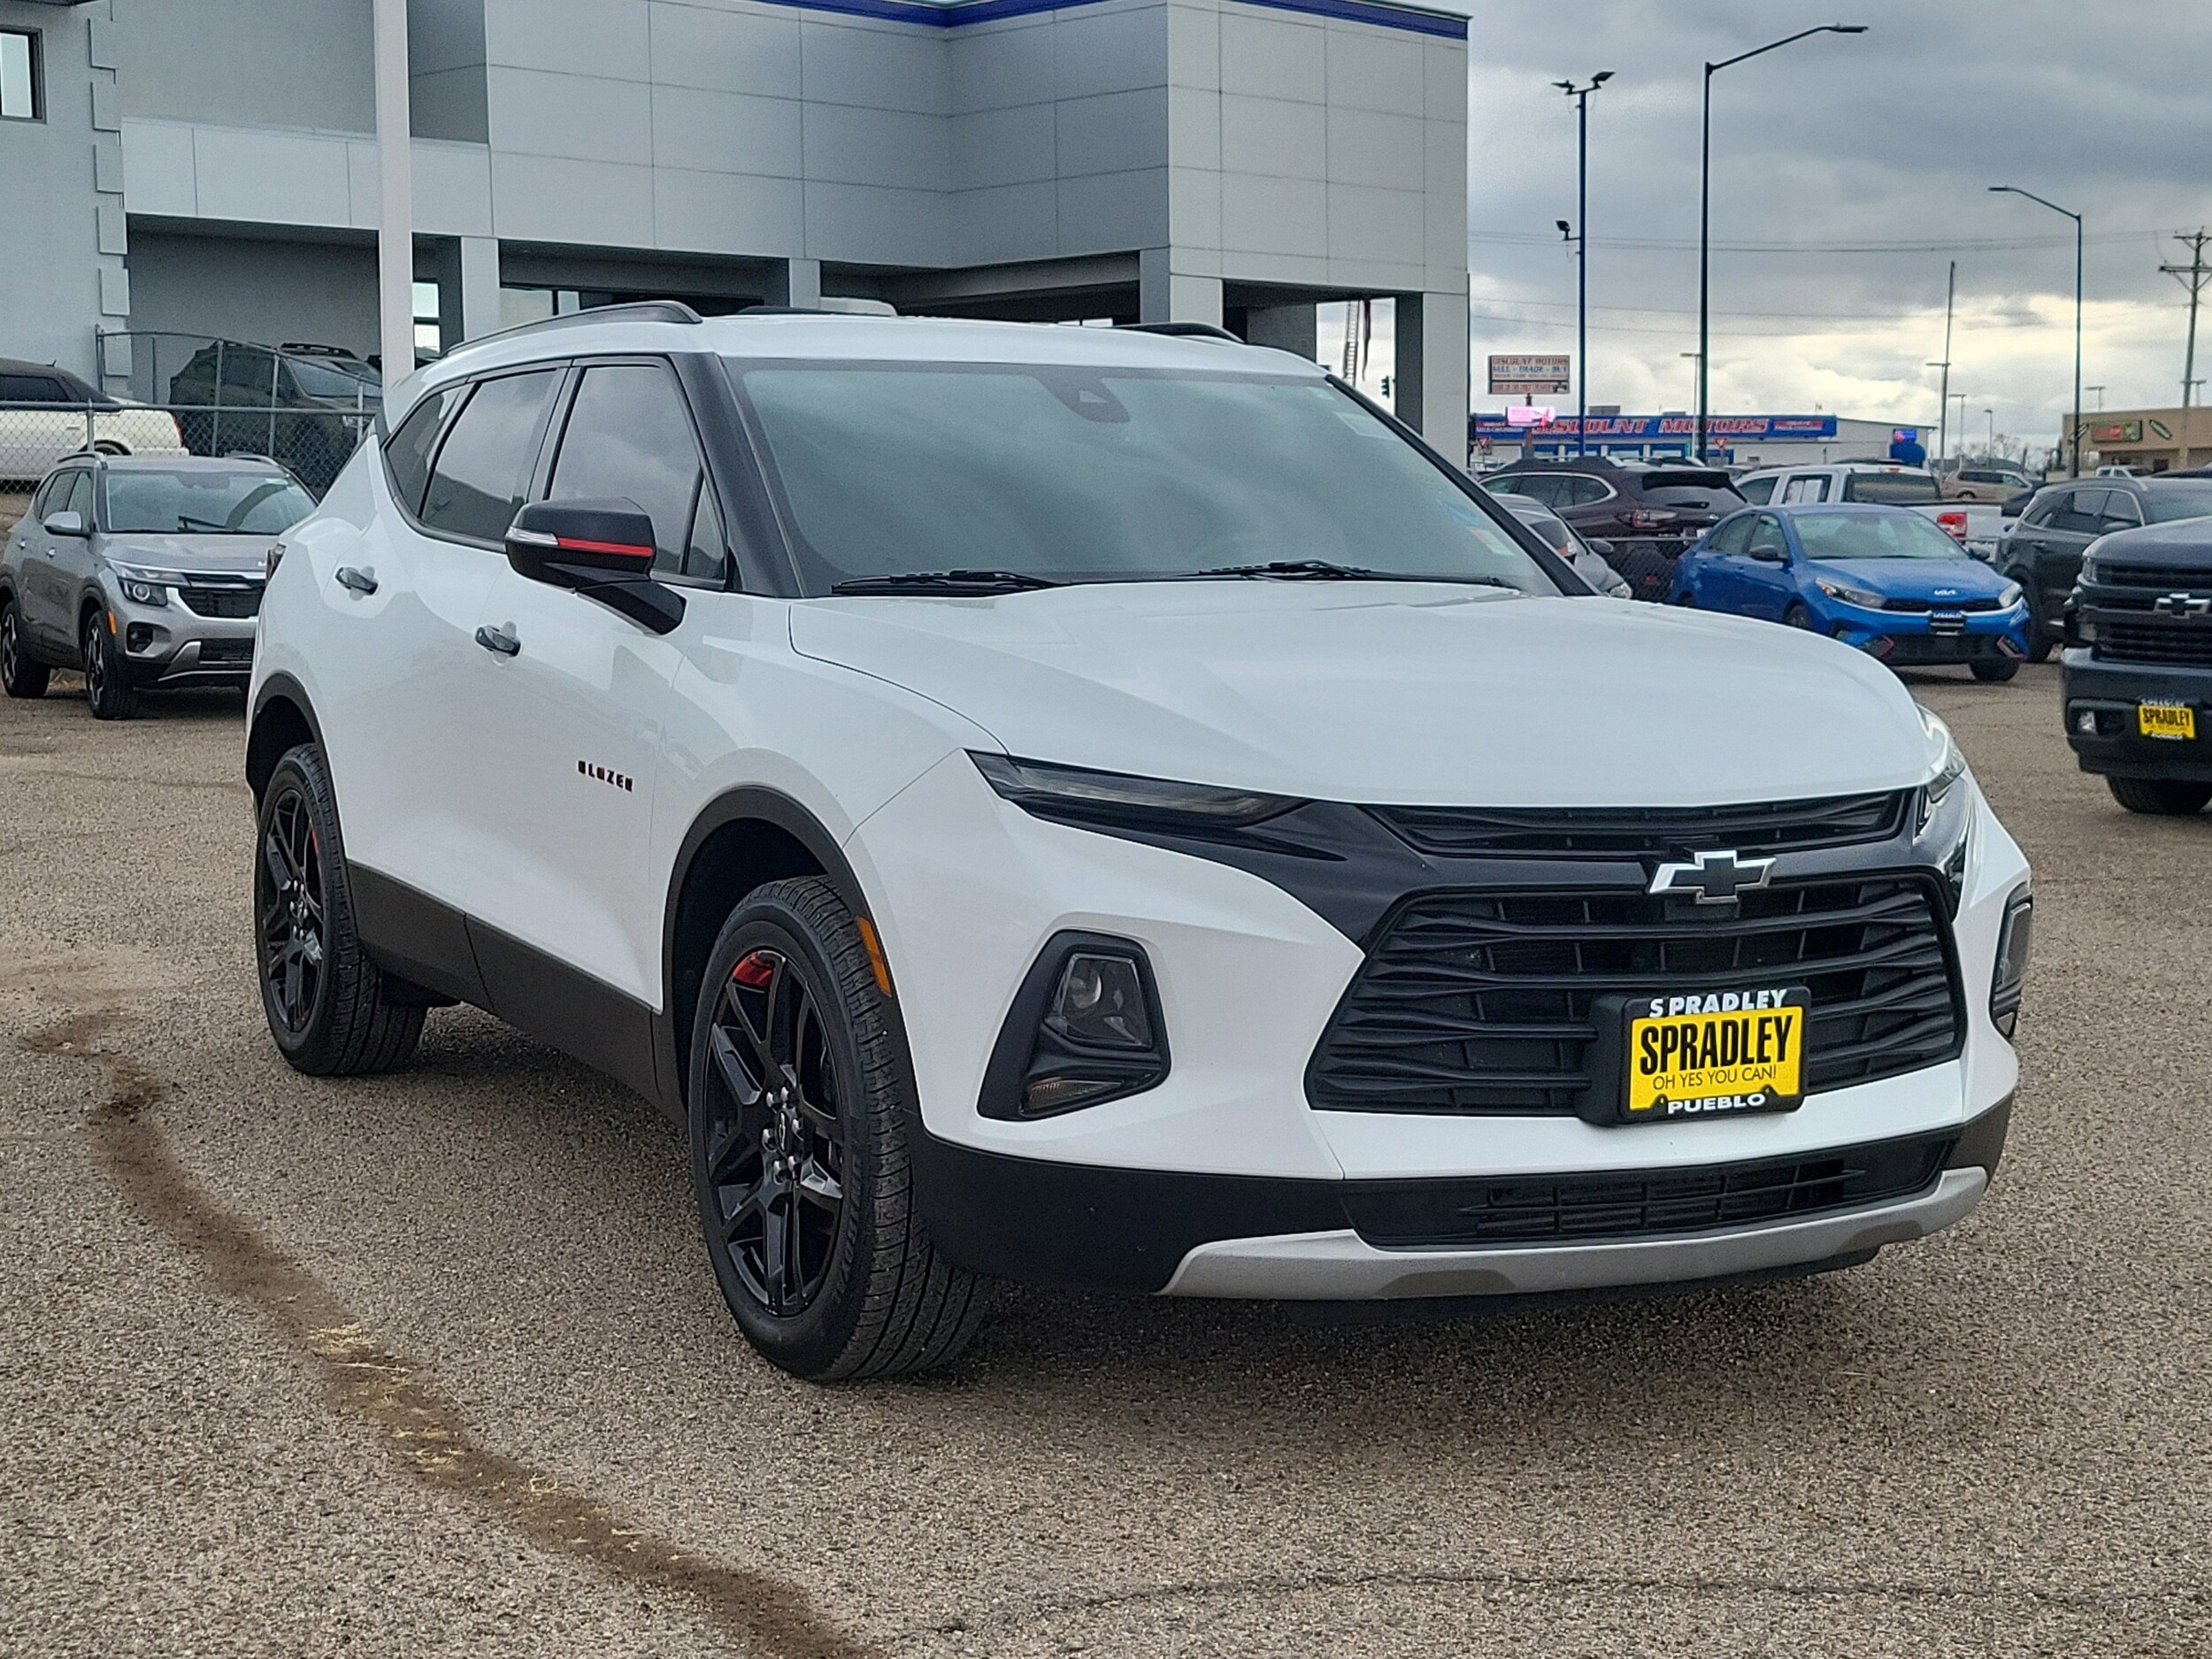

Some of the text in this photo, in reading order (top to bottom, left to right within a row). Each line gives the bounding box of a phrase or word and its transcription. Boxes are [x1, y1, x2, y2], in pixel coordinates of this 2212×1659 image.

[2142, 708, 2190, 726] SPRADLEY
[578, 760, 633, 793] BLAZER
[1648, 988, 1787, 1018] SPRADLEY
[1640, 1014, 1793, 1076] SPRADLEY
[1653, 1064, 1777, 1090] OH YES YOU CAN!
[1668, 1093, 1766, 1114] PUEBLO
